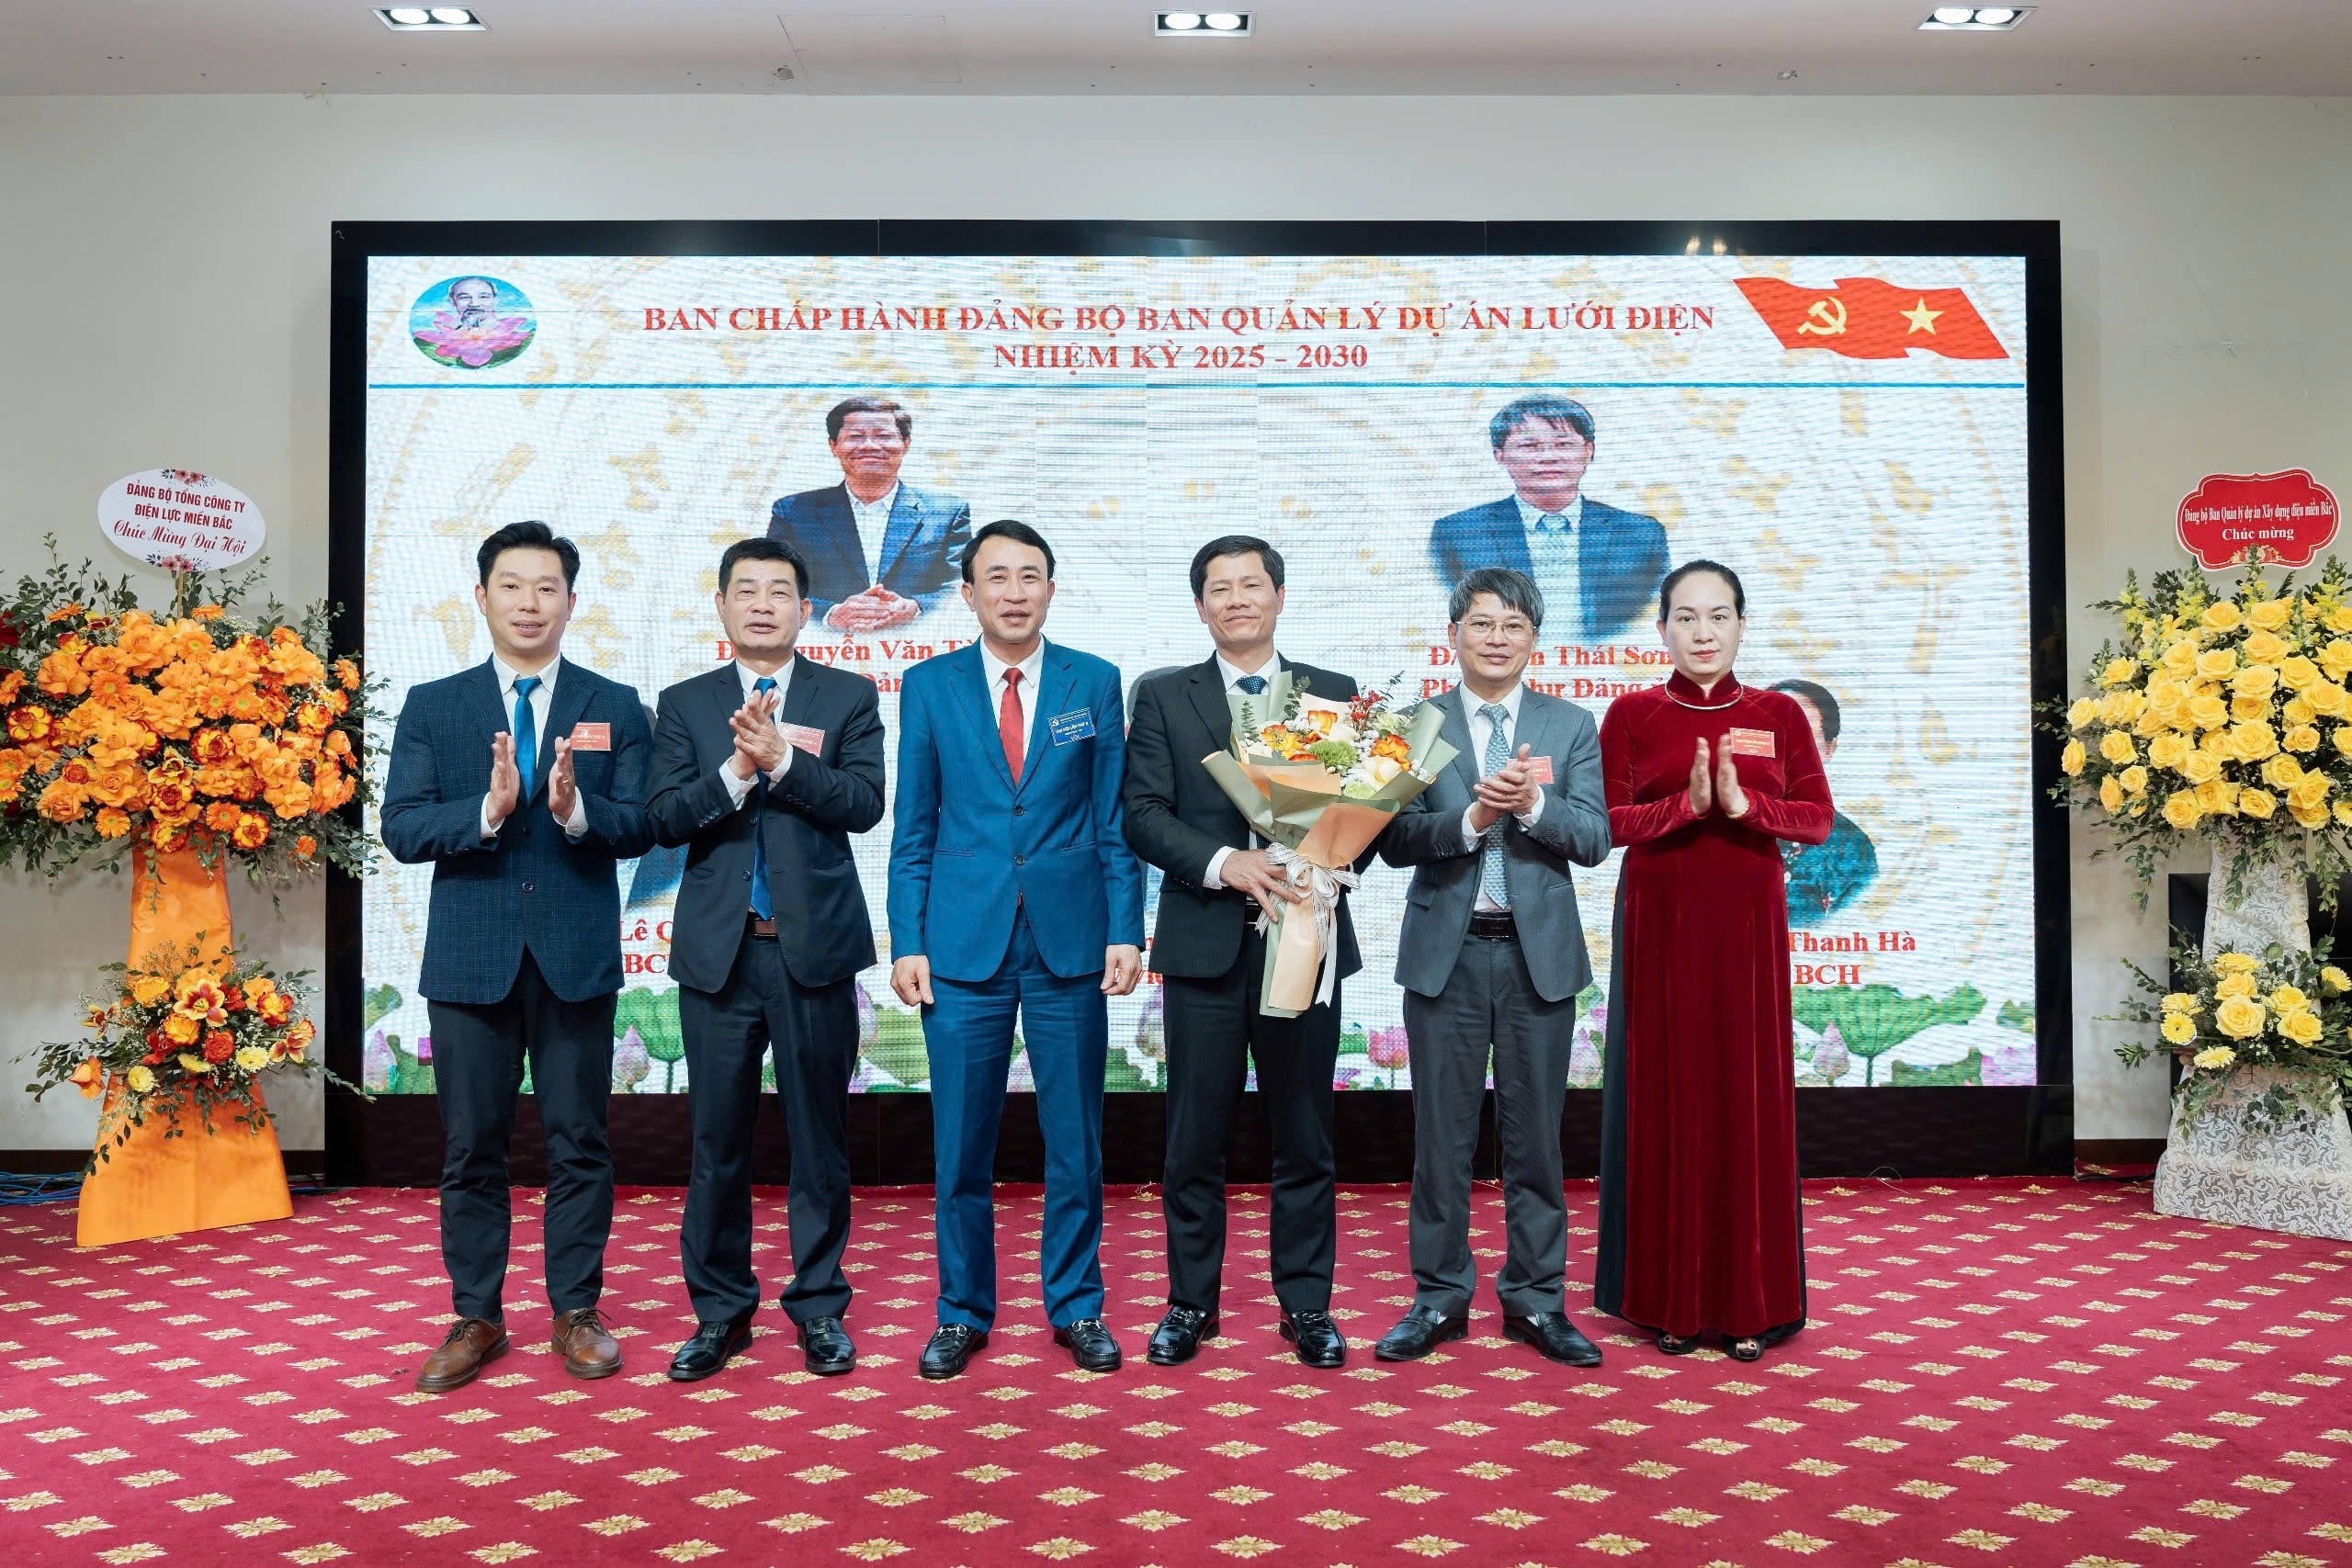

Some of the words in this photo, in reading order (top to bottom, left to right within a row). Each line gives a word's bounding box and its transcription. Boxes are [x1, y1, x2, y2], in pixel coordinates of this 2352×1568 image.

[643, 308, 719, 330] BAN
[729, 300, 831, 330] CHẤP
[840, 301, 948, 331] HÀNH
[957, 299, 1065, 331] ĐẢNG
[1074, 304, 1125, 337] BỘ
[1136, 307, 1212, 331] BAN
[1221, 299, 1328, 335] QUẢN
[1338, 300, 1386, 330] LÝ
[1396, 302, 1453, 337] DỰ
[1461, 300, 1511, 330] ÁN
[1522, 300, 1616, 330] LƯỚI
[1625, 303, 1715, 336] ĐIỆN
[993, 342, 1119, 376] NHIỆM
[1130, 339, 1184, 368] KỲ
[1194, 344, 1265, 368] 2025
[1296, 344, 1368, 367] 2030
[126, 479, 155, 499] ĐẢNG
[157, 487, 173, 504] BỘ
[175, 488, 201, 506] TỔNG
[203, 494, 232, 512] CÔNG
[233, 501, 245, 513] TY
[134, 502, 160, 520] ĐIỆN
[162, 507, 181, 524] LỰC
[184, 510, 210, 526] MIỀN
[212, 514, 232, 530] BẮC
[2209, 507, 2221, 521] Ban
[2221, 505, 2237, 524] Quản
[113, 519, 147, 540] Chúc
[190, 532, 217, 553] Đại
[220, 536, 246, 558] Hội
[2222, 527, 2255, 540] Chúc
[2258, 525, 2294, 541] mừng
[878, 639, 933, 660] Văn
[1554, 645, 1616, 666] Thái
[1788, 931, 1869, 952] Thanh
[1877, 931, 1917, 952] Hà
[1793, 964, 1861, 985] BCH
